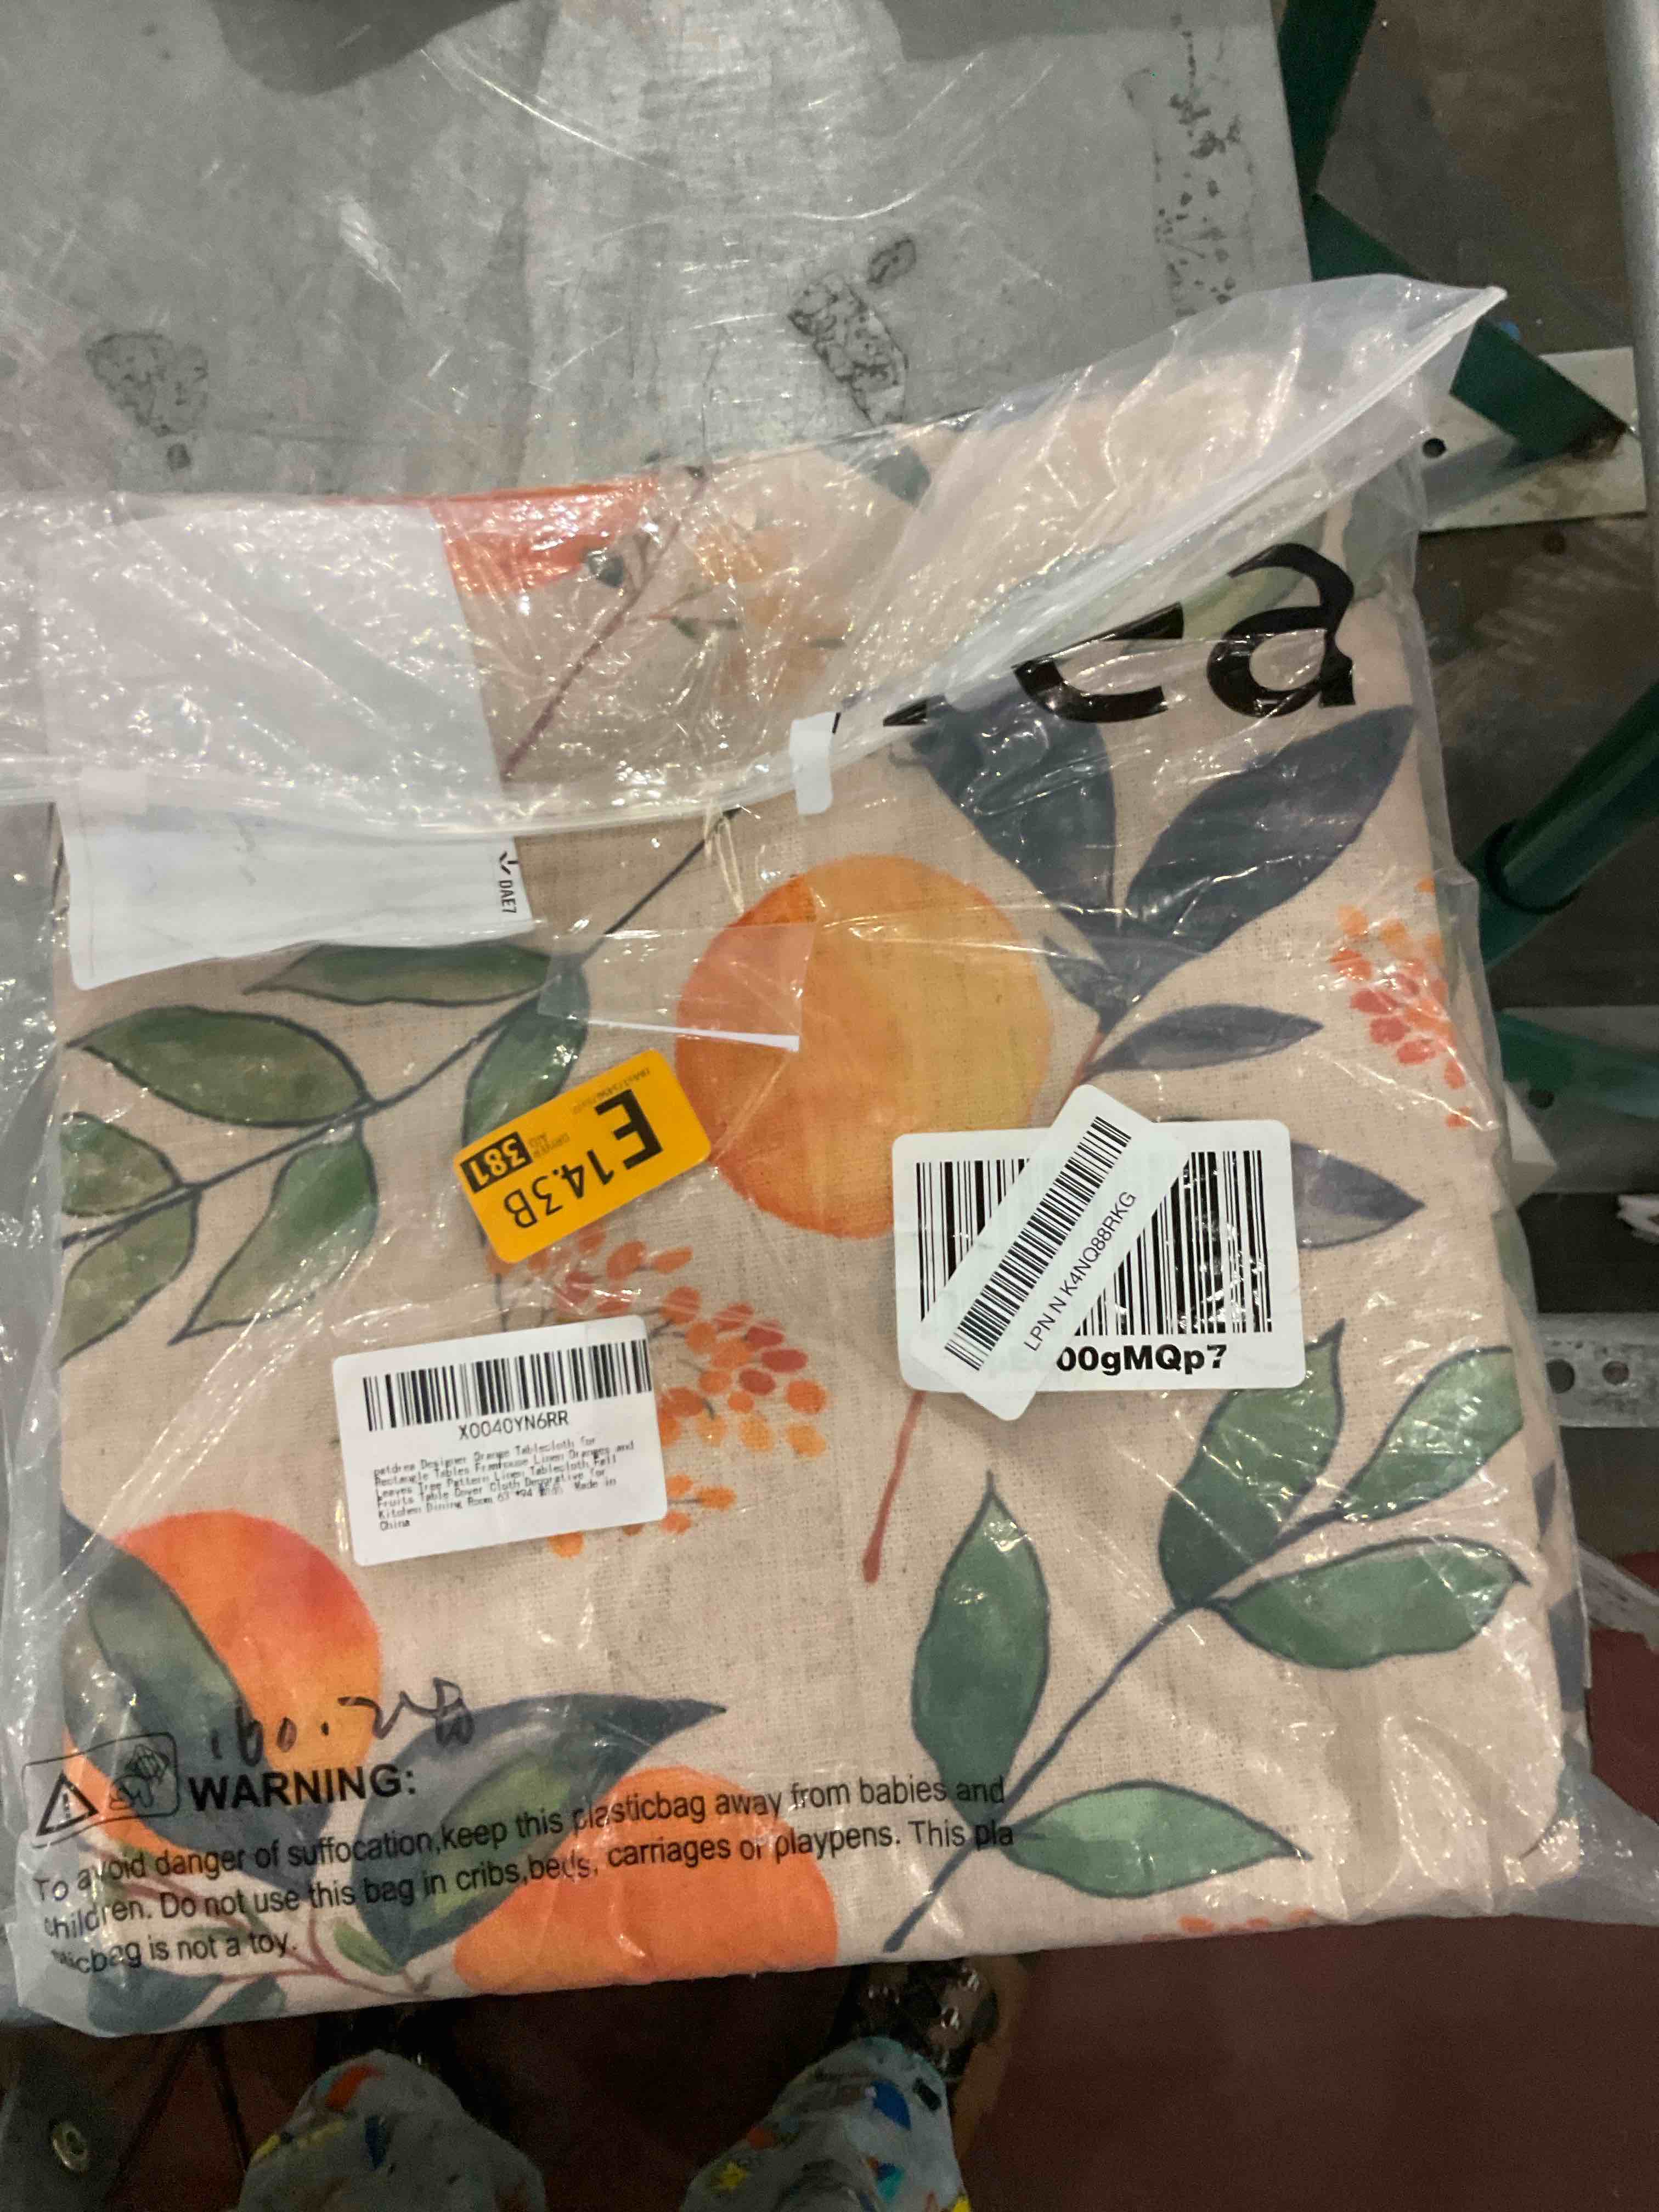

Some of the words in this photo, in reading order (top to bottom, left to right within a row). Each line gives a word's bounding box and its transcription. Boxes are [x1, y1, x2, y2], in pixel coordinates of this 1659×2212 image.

[499, 880, 517, 913] DAE7
[467, 1138, 527, 1186] 381
[1024, 1312, 1056, 1351] LPN
[1059, 1191, 1137, 1297] K4NQ88RKG
[458, 1410, 569, 1440] X0040YN6RR
[188, 1764, 416, 1811] WARNING:
[32, 1877, 69, 1901] To
[157, 1845, 246, 1880] danger
[255, 1838, 280, 1867] of
[515, 1808, 565, 1840] this
[573, 1791, 706, 1837] plasticbag
[715, 1790, 782, 1821] away
[791, 1781, 851, 1810] from
[859, 1774, 948, 1805] babies
[956, 1775, 1005, 1805] and
[160, 1892, 196, 1918] Do
[205, 1889, 248, 1917] not
[253, 1889, 301, 1914] use
[308, 1881, 356, 1909] this
[364, 1877, 414, 1906] bag
[422, 1868, 447, 1894] in
[607, 1836, 732, 1869] carriages
[739, 1839, 764, 1860] or
[775, 1823, 901, 1865] playpens.
[908, 1819, 967, 1848] This
[974, 1819, 1015, 1852] pla
[147, 1935, 170, 1961] is
[177, 1934, 220, 1960] not
[226, 1935, 241, 1958] a
[249, 1929, 298, 1958] toy.
